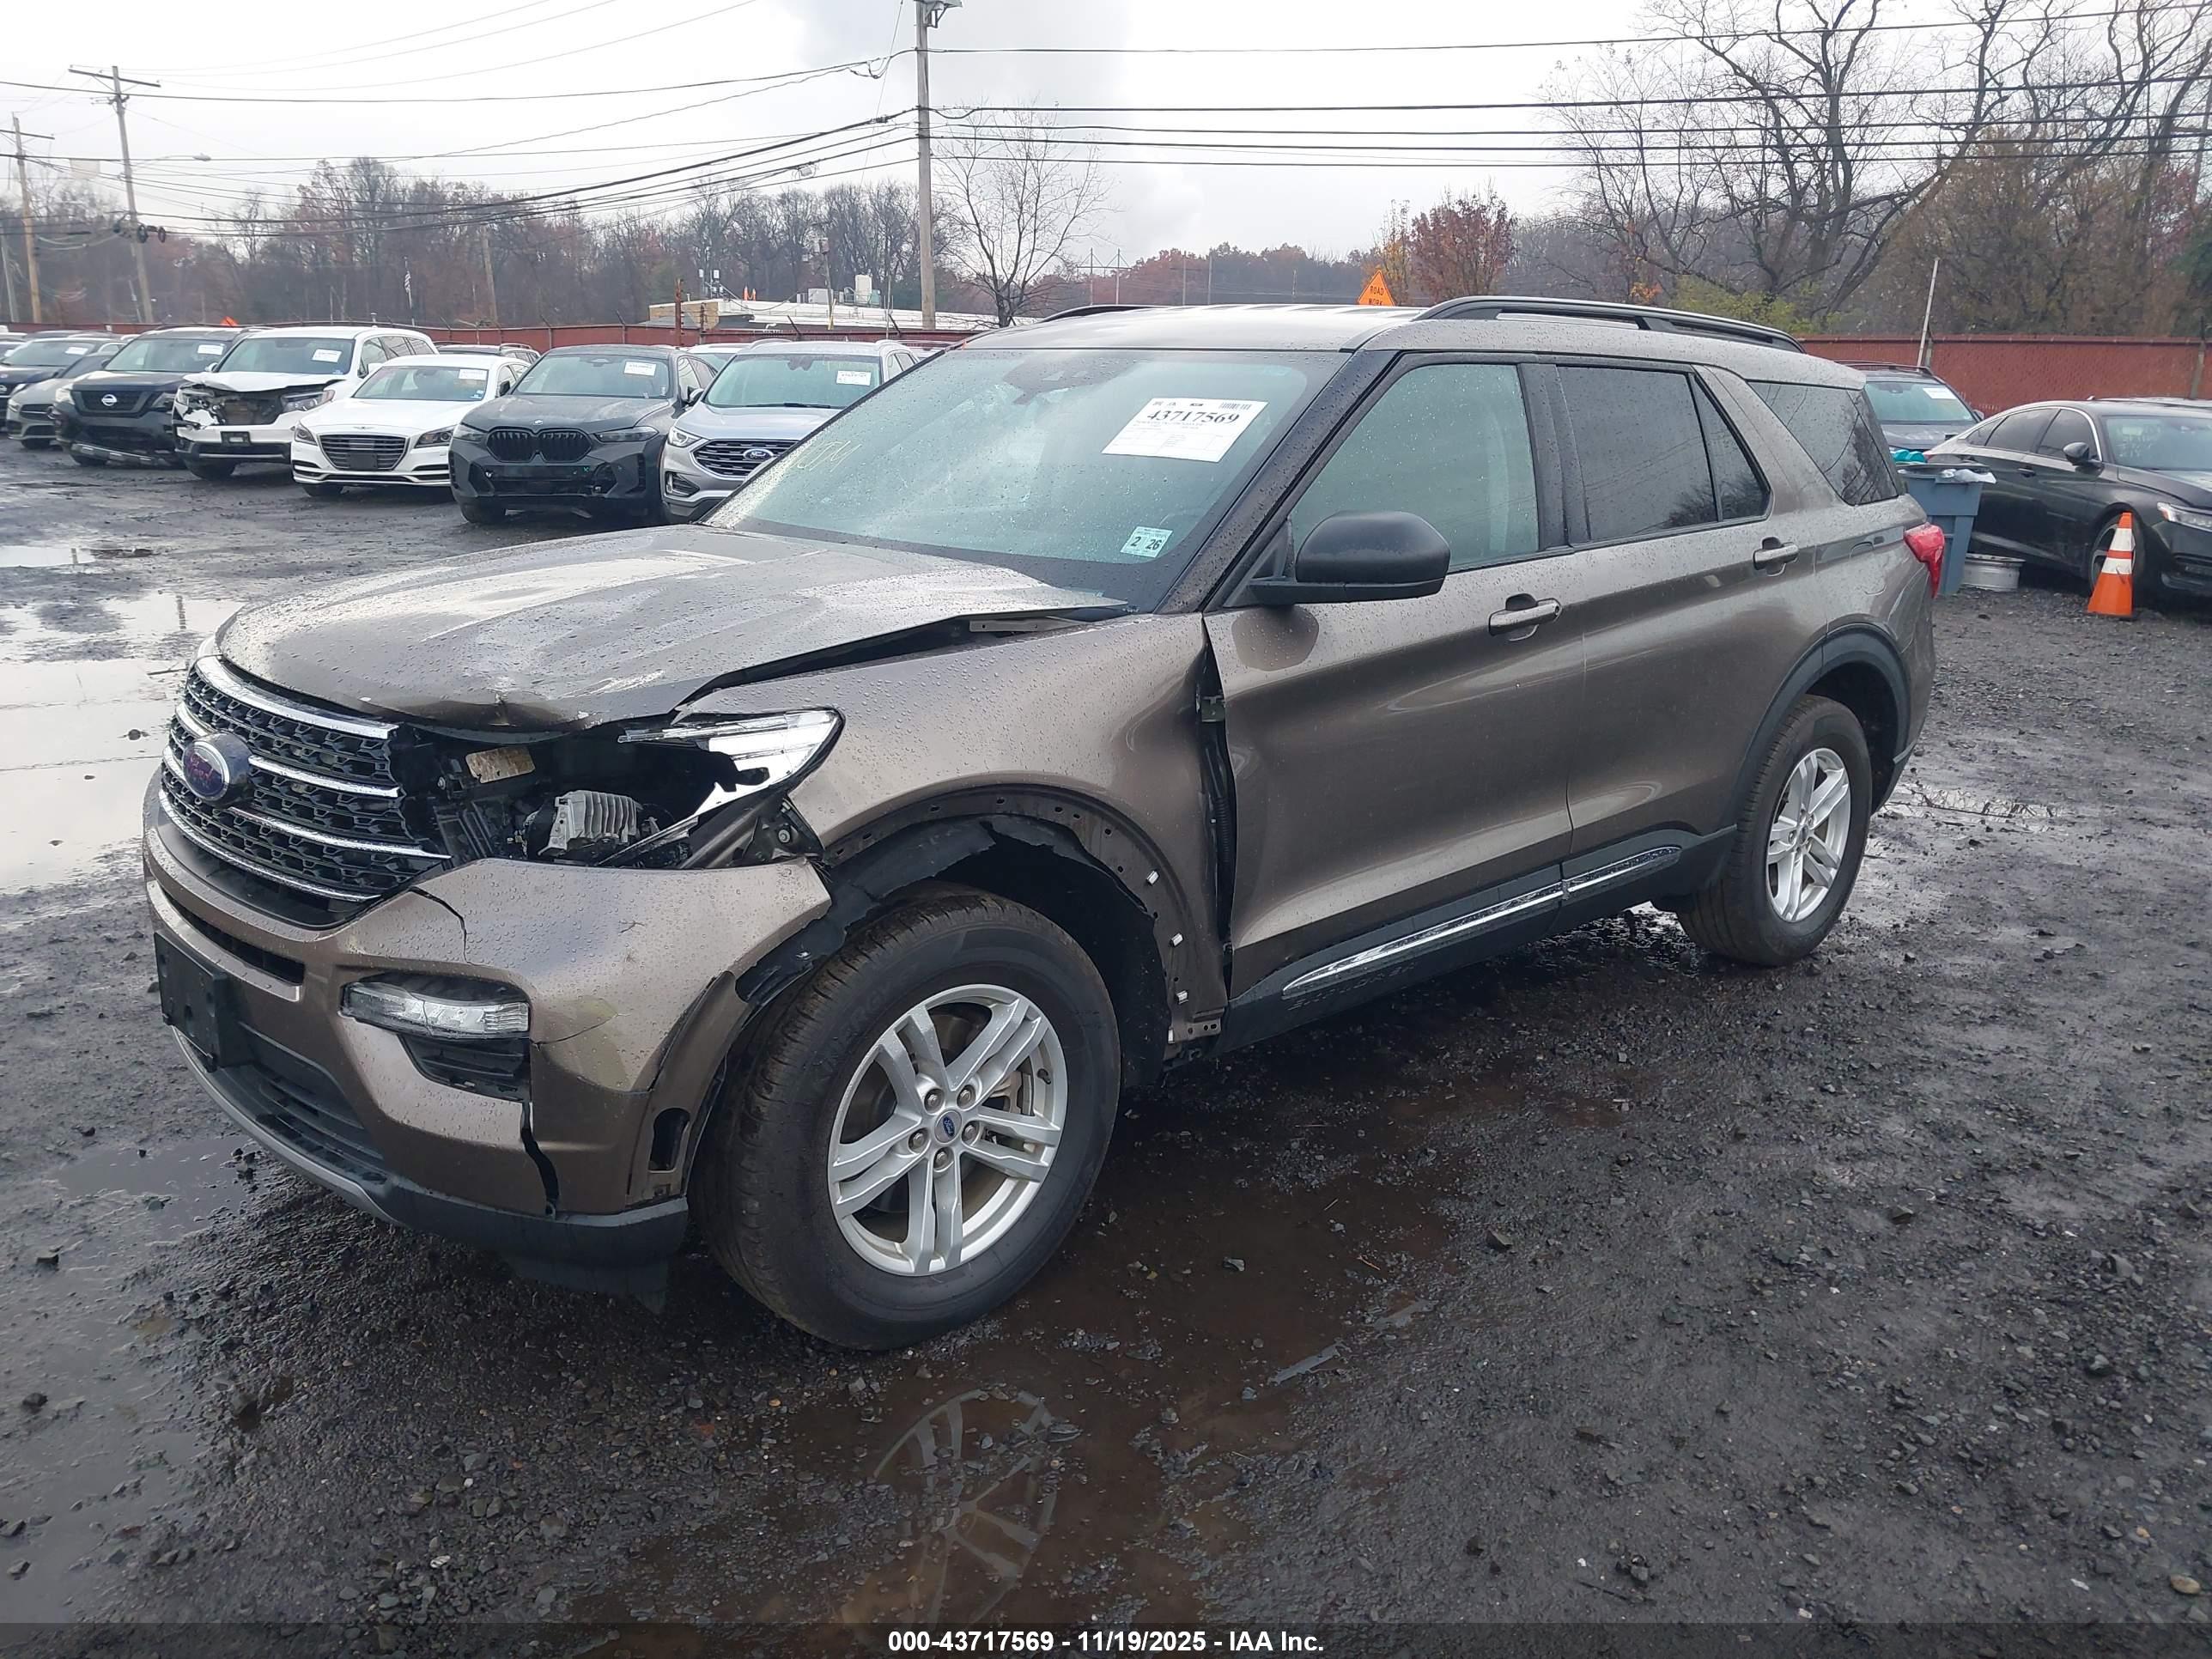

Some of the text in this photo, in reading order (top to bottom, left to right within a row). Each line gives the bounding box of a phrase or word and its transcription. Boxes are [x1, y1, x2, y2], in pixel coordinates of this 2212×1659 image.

[1370, 286, 1384, 295] ROAD
[1147, 410, 1239, 424] 43717569
[1130, 536, 1162, 550] 2 26
